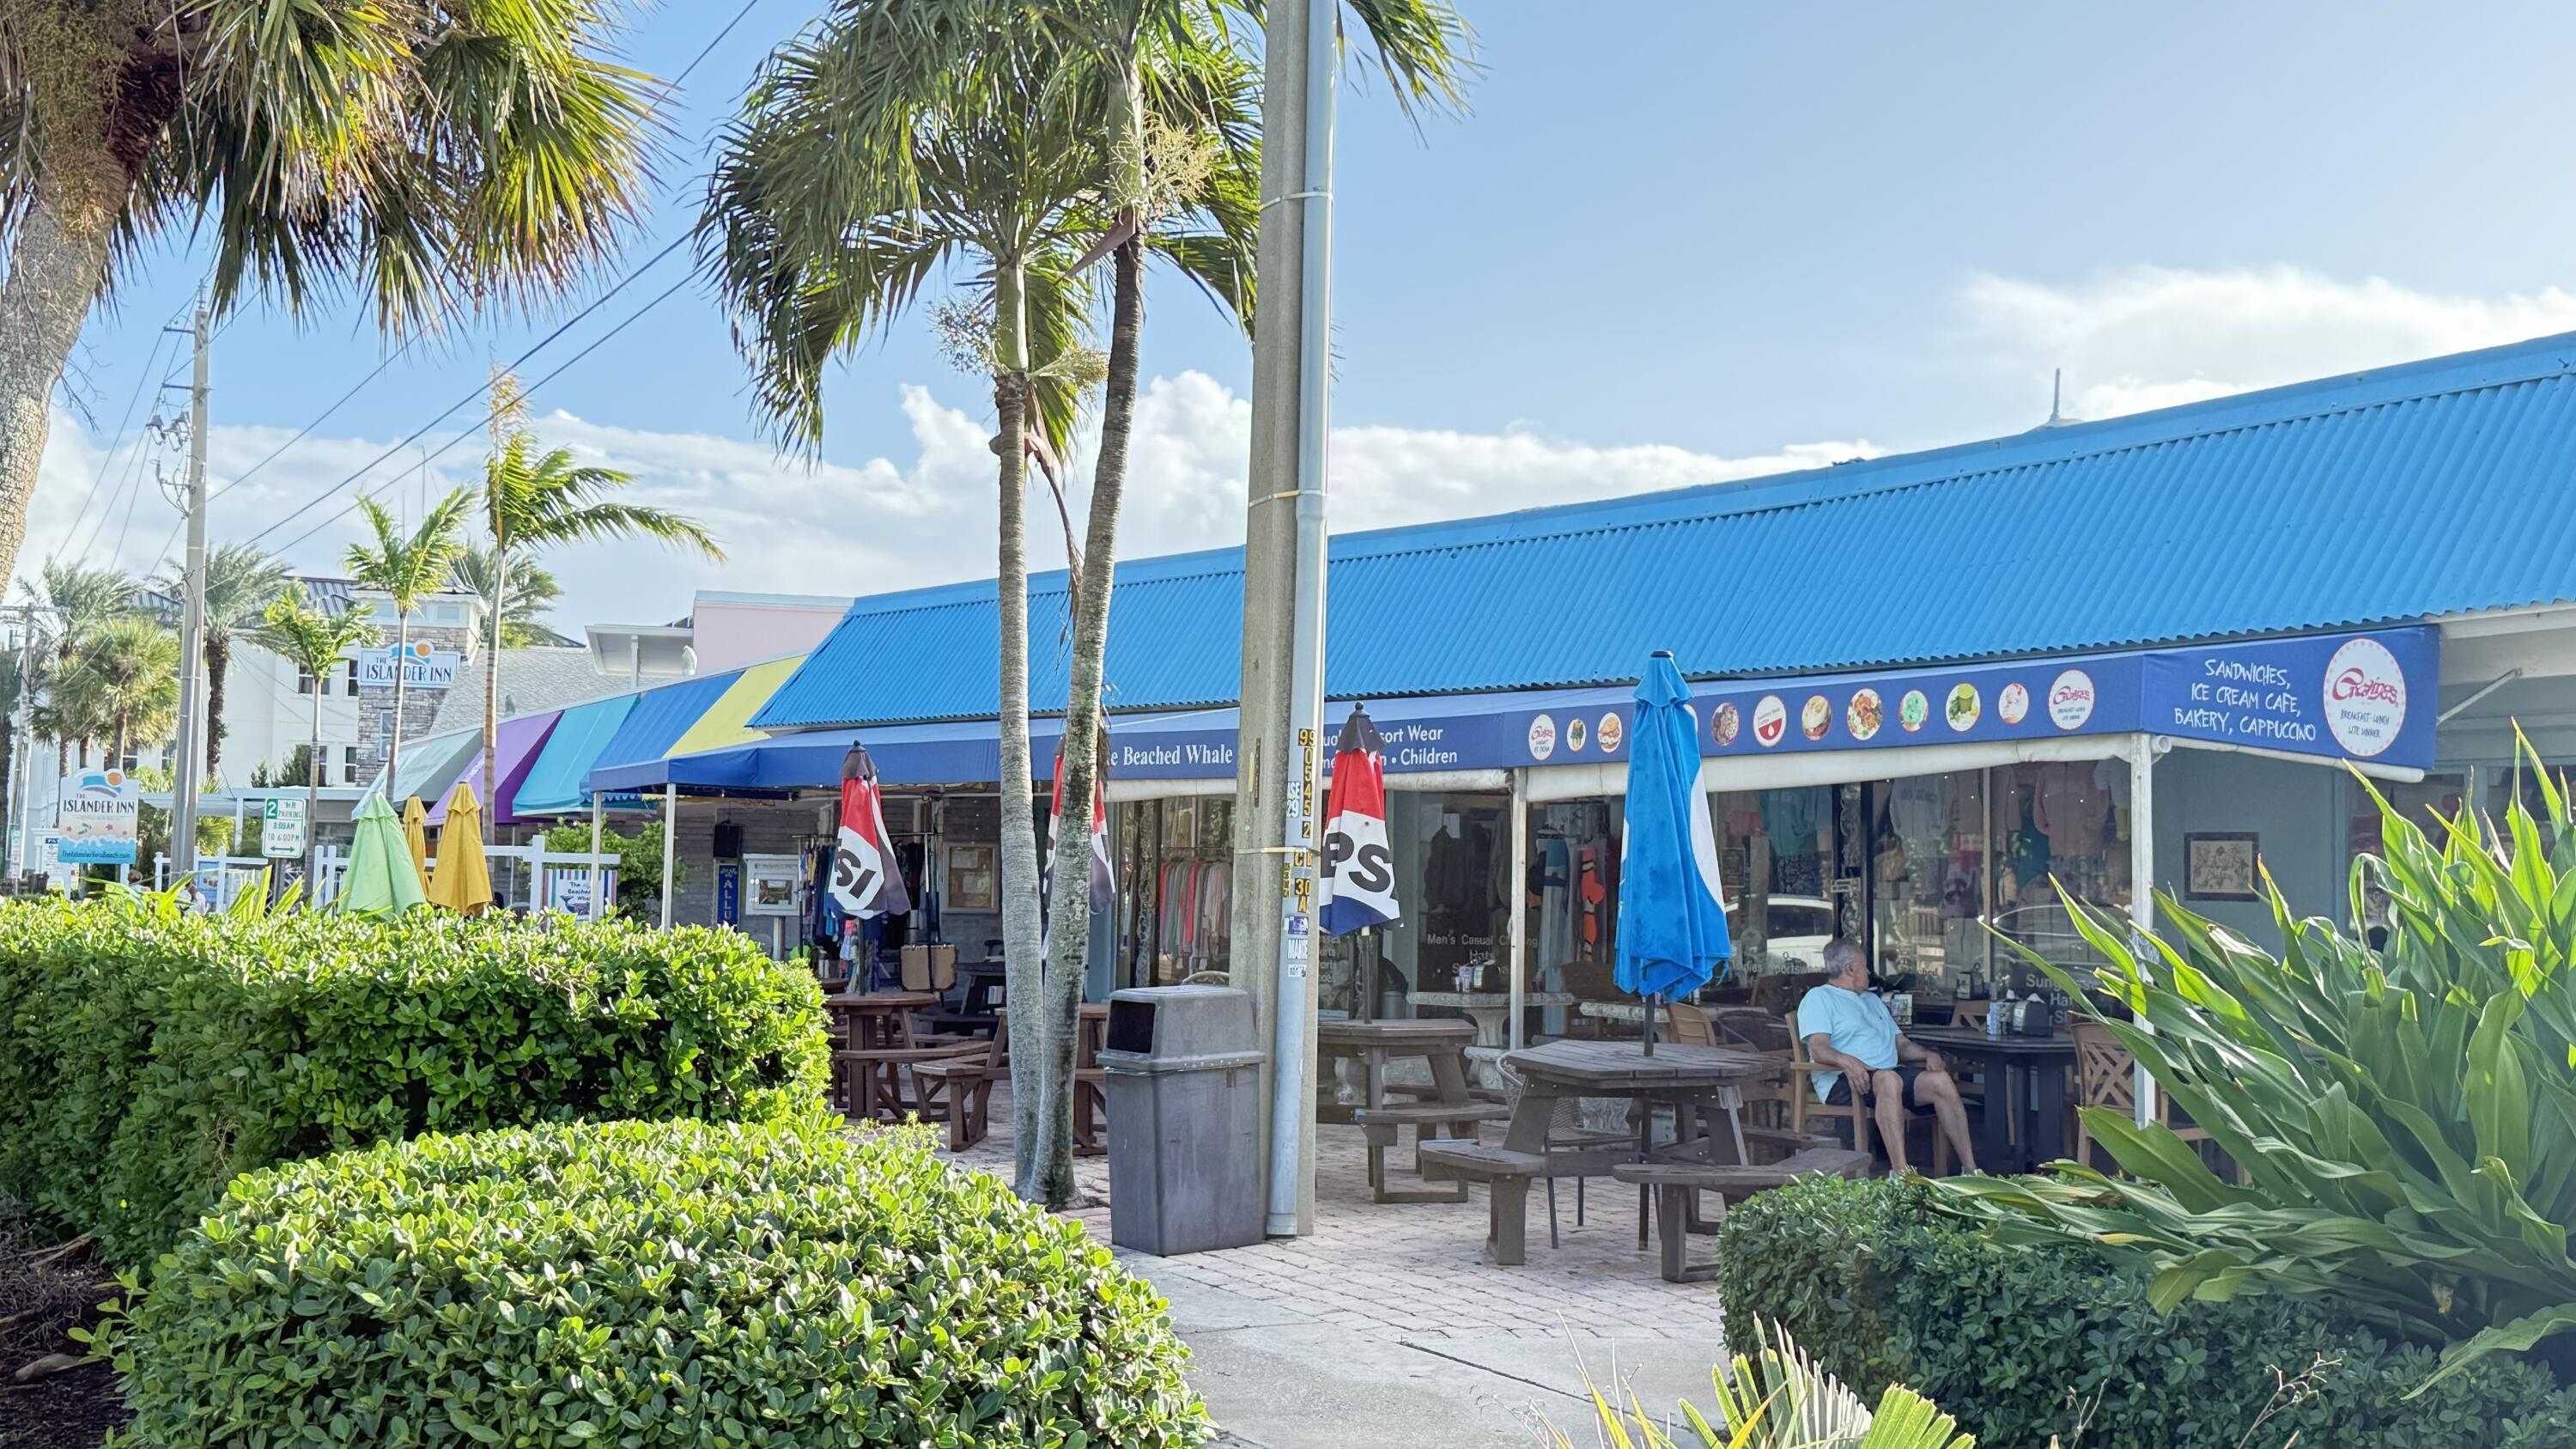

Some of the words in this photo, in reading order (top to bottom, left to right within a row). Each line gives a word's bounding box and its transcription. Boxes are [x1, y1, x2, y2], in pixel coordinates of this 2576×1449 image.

[429, 667, 452, 682] INN
[2204, 659, 2291, 690] SANDWICHES,
[2190, 682, 2210, 702] ICE
[2215, 685, 2259, 709] CREAM
[2264, 691, 2301, 718] CAFE,
[2173, 707, 2233, 736] BAKERY,
[2239, 715, 2317, 741] CAPPUCCINO
[1379, 728, 1404, 744] sort
[1407, 724, 1443, 742] Wear
[1123, 745, 1181, 766] Beached
[1185, 743, 1233, 764] Whale
[1400, 747, 1457, 766] Children
[64, 799, 114, 813] ISLANDER
[117, 801, 135, 813] INN
[267, 801, 277, 817] 2
[1427, 933, 1456, 945] Men's
[1461, 934, 1494, 946] Casual
